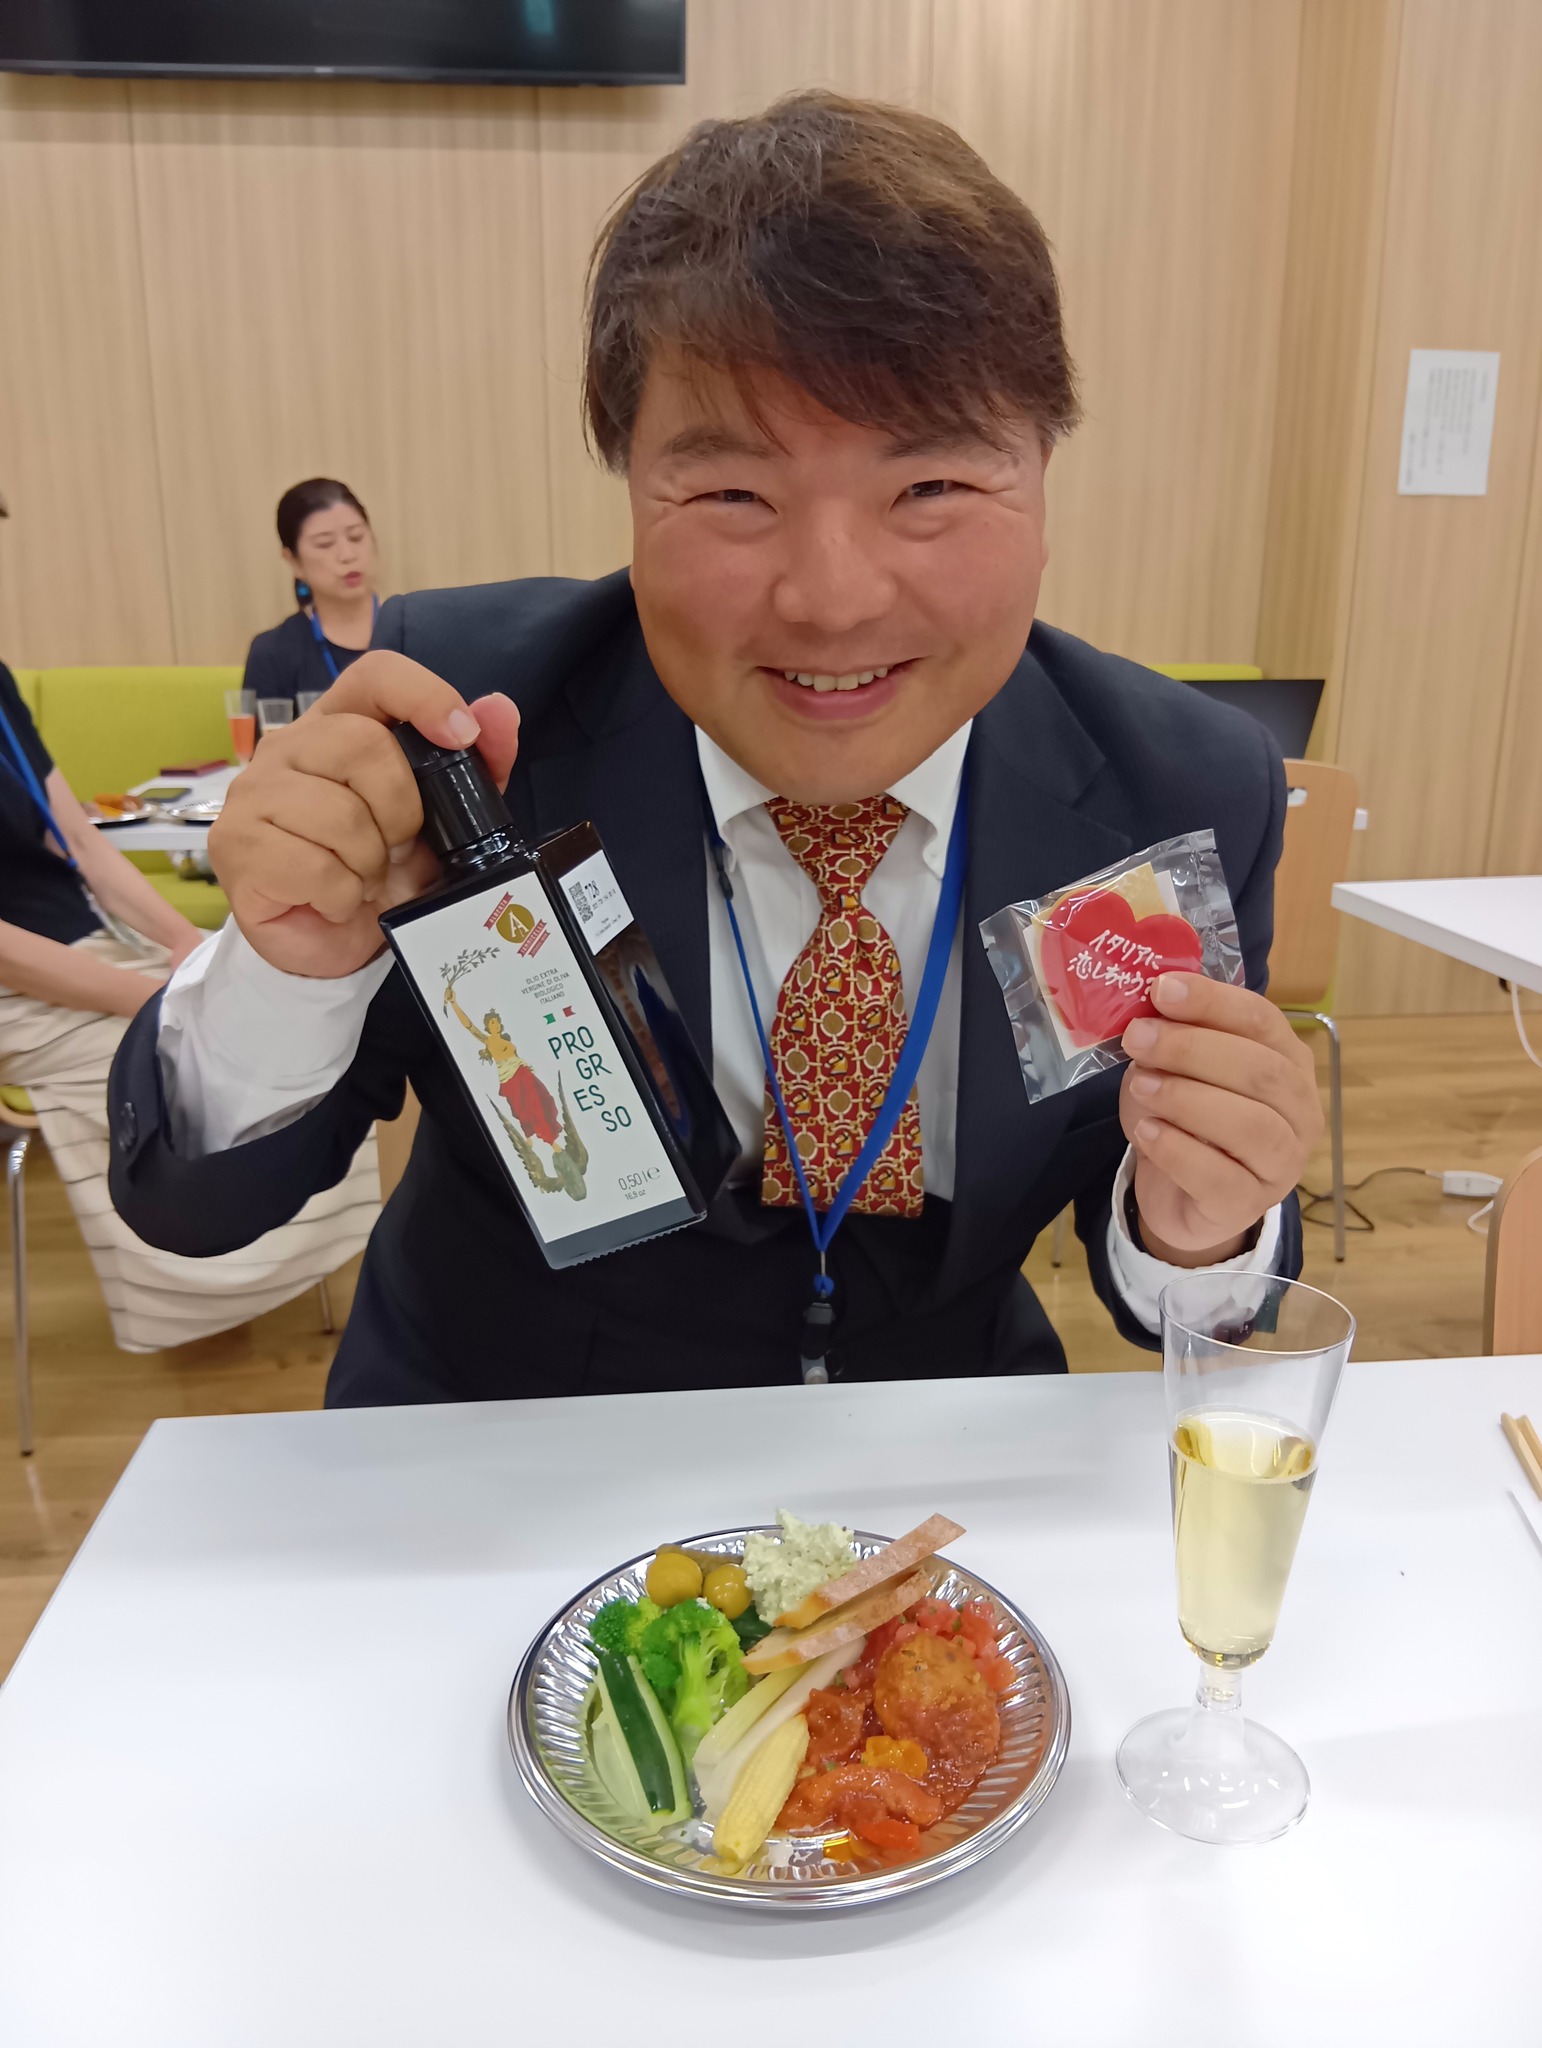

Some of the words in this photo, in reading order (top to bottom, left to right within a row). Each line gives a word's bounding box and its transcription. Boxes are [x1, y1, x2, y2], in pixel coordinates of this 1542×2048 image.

[1088, 929, 1164, 971] イタリアに
[520, 981, 546, 995] VERGINE
[553, 972, 570, 983] OLIVA
[525, 975, 540, 985] OLIO
[540, 968, 559, 980] EXTRA
[1066, 949, 1156, 1002] 恋しちゃう?
[533, 982, 564, 999] BIOLOGICO
[539, 990, 566, 1004] ITALIANO
[548, 1026, 594, 1060] PRO
[575, 1053, 612, 1080] GR
[573, 1084, 605, 1112] ES
[601, 1105, 632, 1132] SO
[618, 1172, 643, 1191] 0,50
[624, 1190, 638, 1200] 16,9
[638, 1189, 647, 1197] oz
